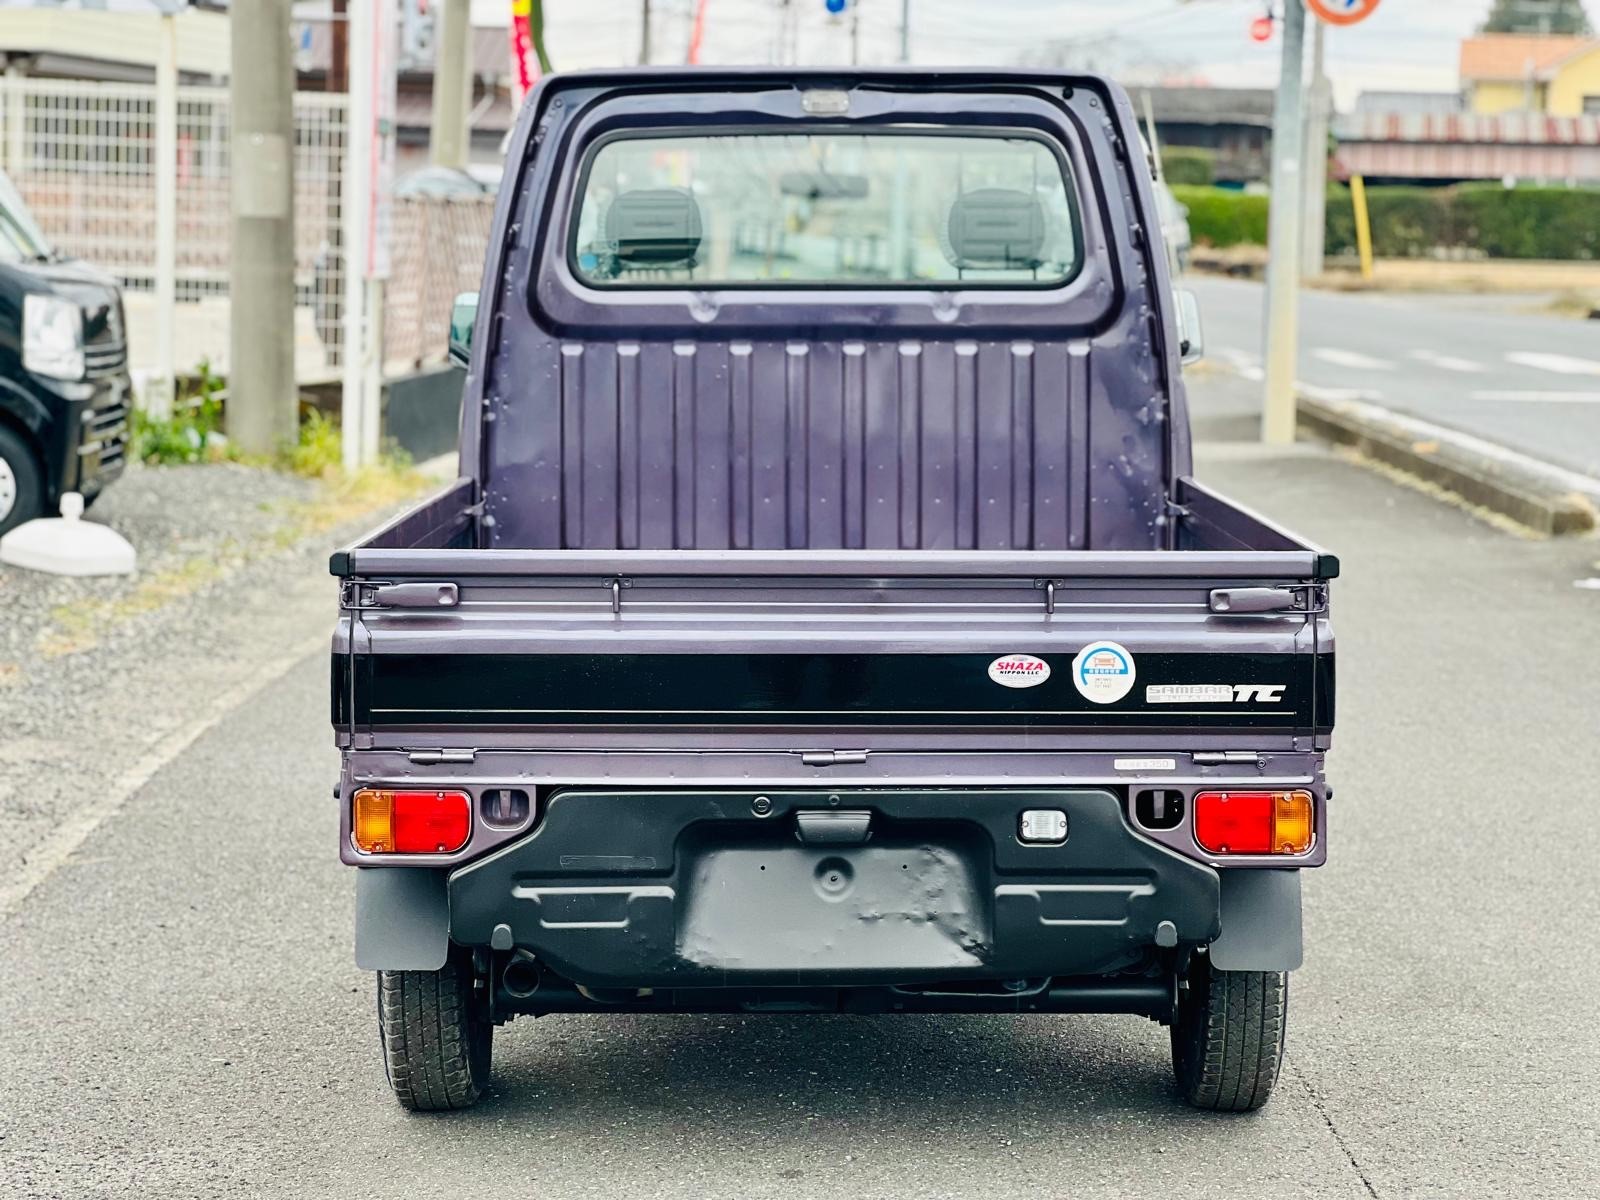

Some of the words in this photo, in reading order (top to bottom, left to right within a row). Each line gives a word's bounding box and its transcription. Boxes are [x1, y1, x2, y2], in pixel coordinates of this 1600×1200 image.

[996, 662, 1043, 671] SHAZA
[1147, 686, 1231, 695] SAMBAR
[1233, 684, 1287, 703] TC
